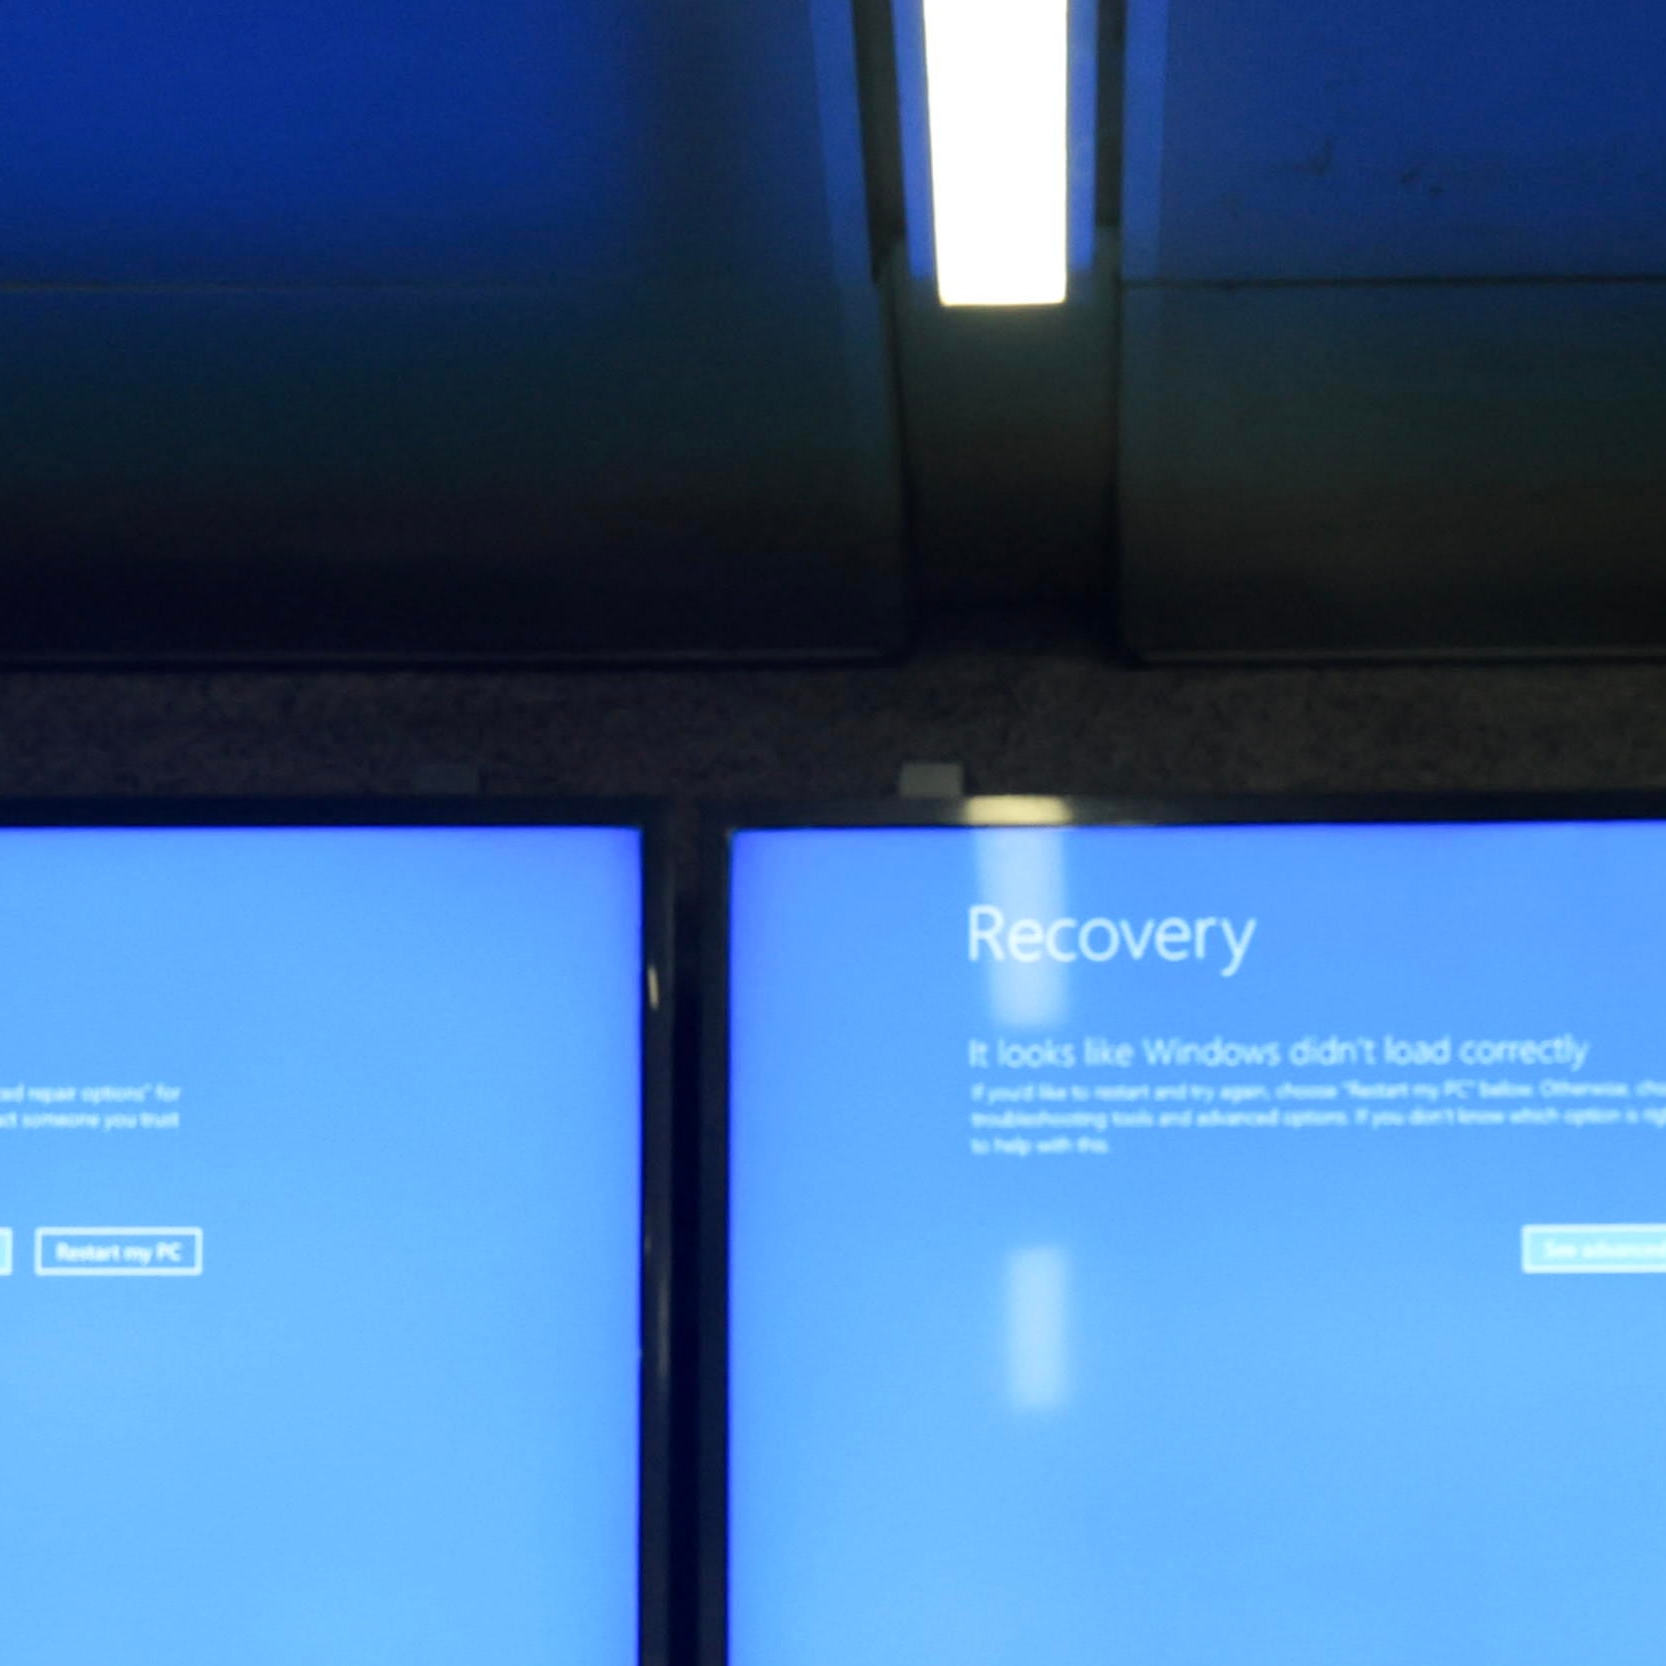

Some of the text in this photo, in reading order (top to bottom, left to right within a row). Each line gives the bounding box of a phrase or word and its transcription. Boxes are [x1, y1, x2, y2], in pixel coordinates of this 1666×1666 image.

[969, 905, 1256, 978] Recovery
[968, 1033, 1590, 1071] It looks like Windows didn't load correctly
[56, 1241, 181, 1265] Restart my PC
